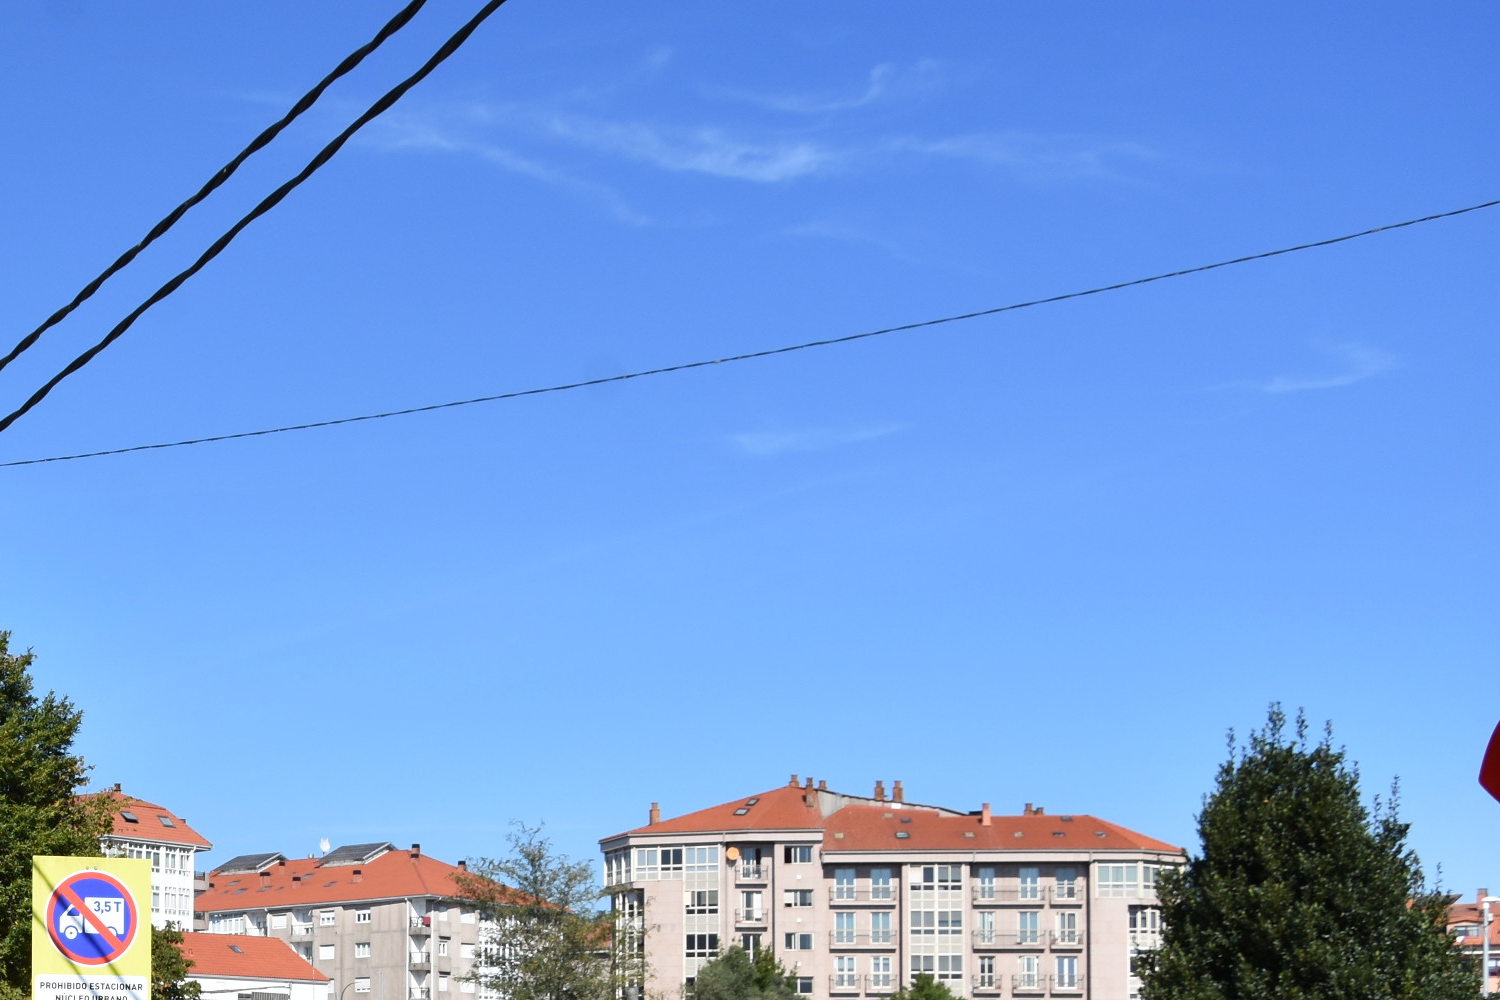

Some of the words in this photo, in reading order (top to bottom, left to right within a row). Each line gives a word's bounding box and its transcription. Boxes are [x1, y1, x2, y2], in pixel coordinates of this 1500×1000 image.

[94, 901, 111, 914] 3,5
[114, 901, 121, 913] T
[40, 982, 87, 990] PROHIBIDO
[89, 982, 143, 991] ESTACIONAR
